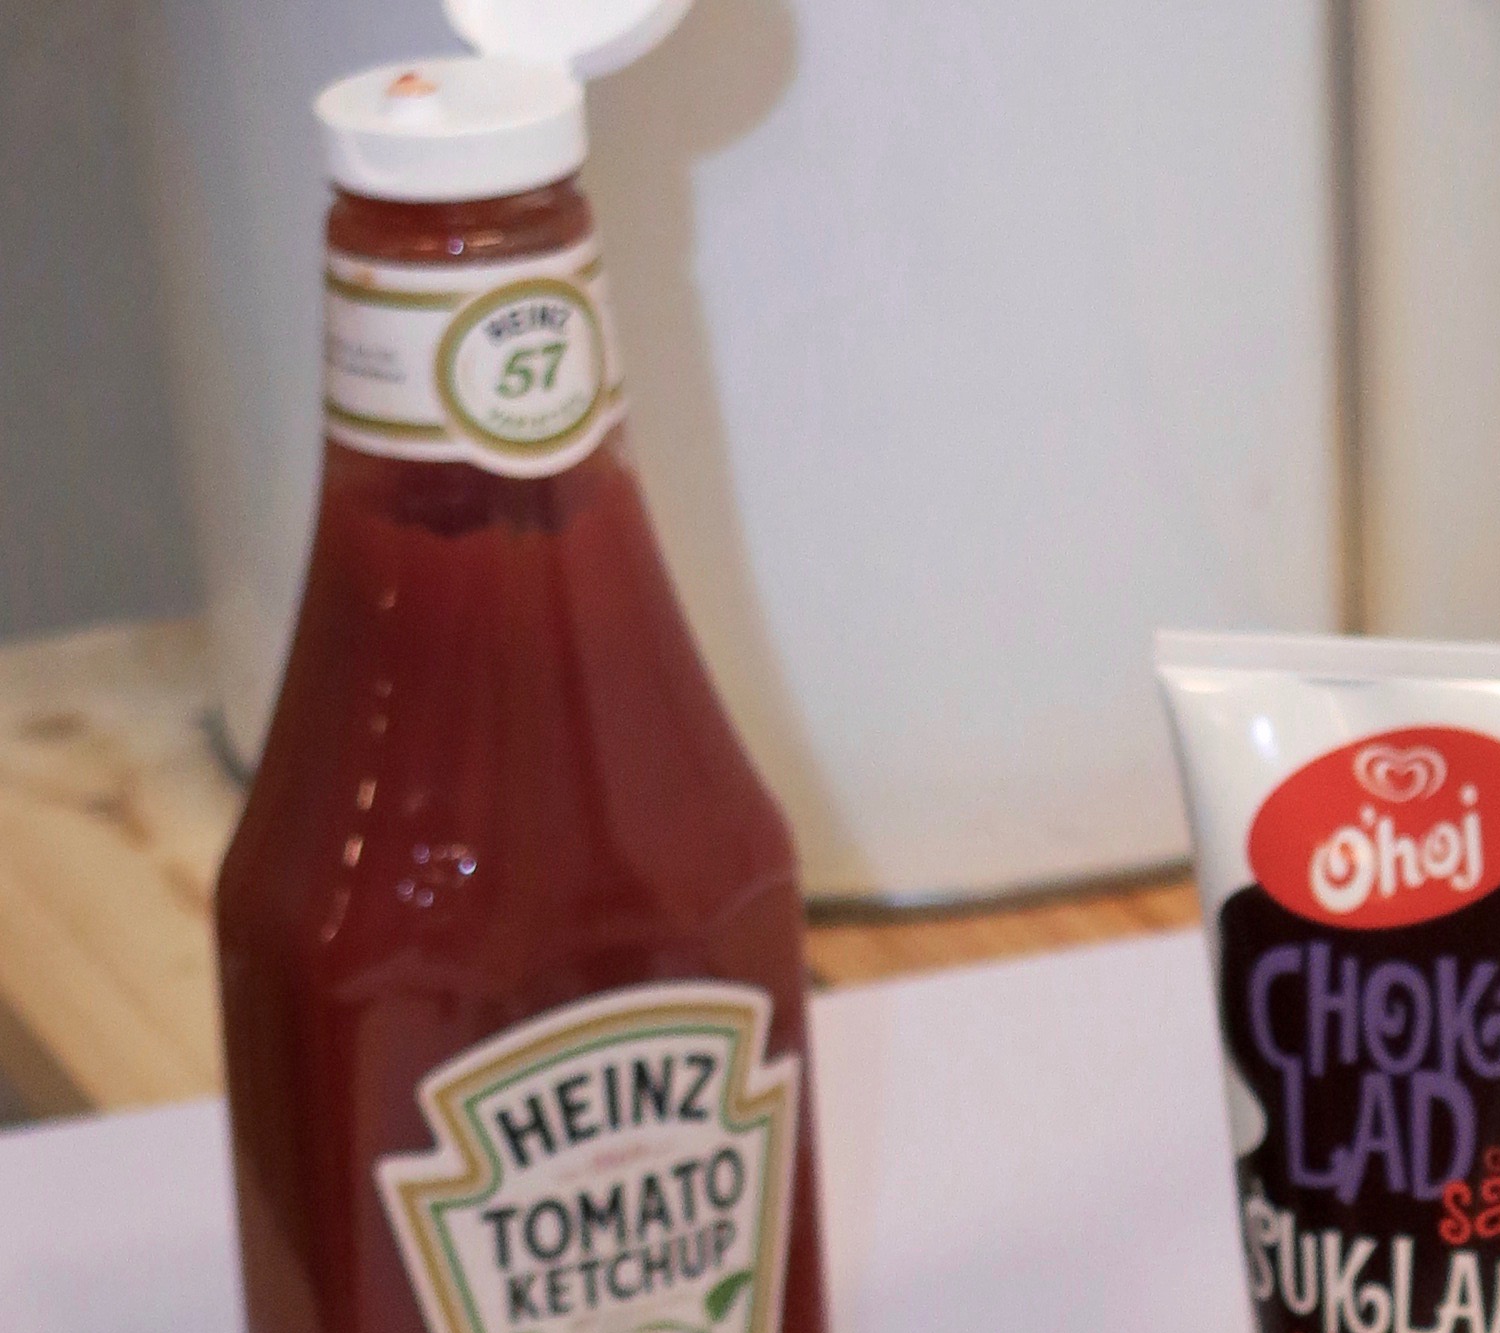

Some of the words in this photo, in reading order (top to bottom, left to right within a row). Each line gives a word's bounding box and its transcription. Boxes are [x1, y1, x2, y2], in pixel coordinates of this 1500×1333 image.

[495, 340, 568, 398] 57
[495, 1050, 718, 1168] HEINZ
[1282, 1066, 1478, 1206] LAD
[481, 1146, 745, 1272] TOMATO
[507, 1218, 739, 1323] KETCHUP
